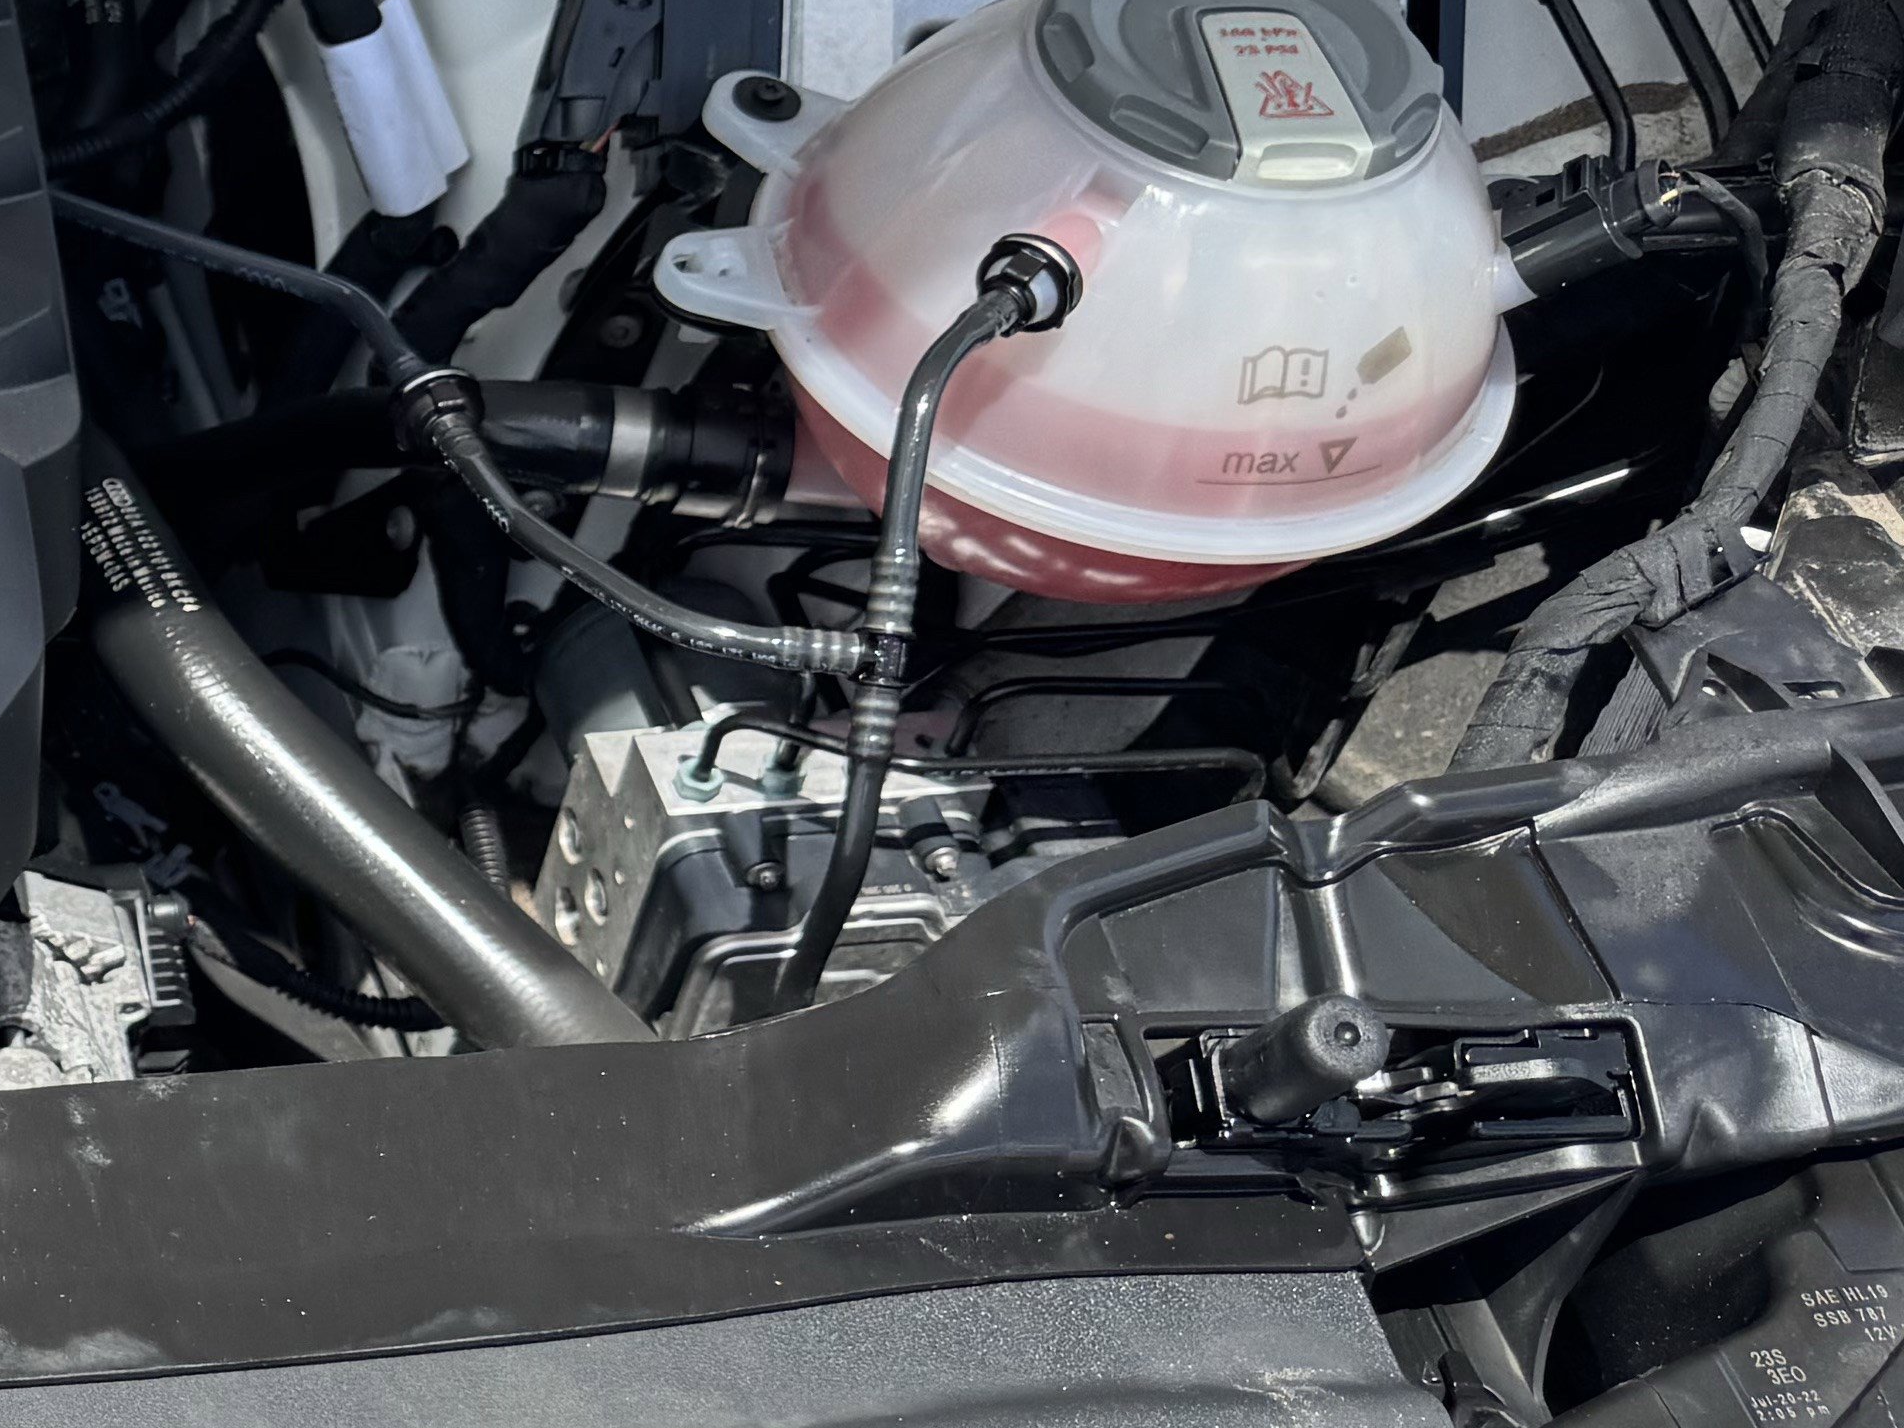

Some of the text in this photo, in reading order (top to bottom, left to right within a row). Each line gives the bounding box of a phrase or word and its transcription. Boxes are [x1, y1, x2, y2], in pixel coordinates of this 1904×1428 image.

[1222, 451, 1300, 474] max
[1800, 1284, 1889, 1307] SAE HL19
[1813, 1310, 1852, 1328] SSB
[1750, 1348, 1787, 1368] 23S
[1750, 1390, 1822, 1409] Jul-20-22
[1806, 1405, 1831, 1418] pm
